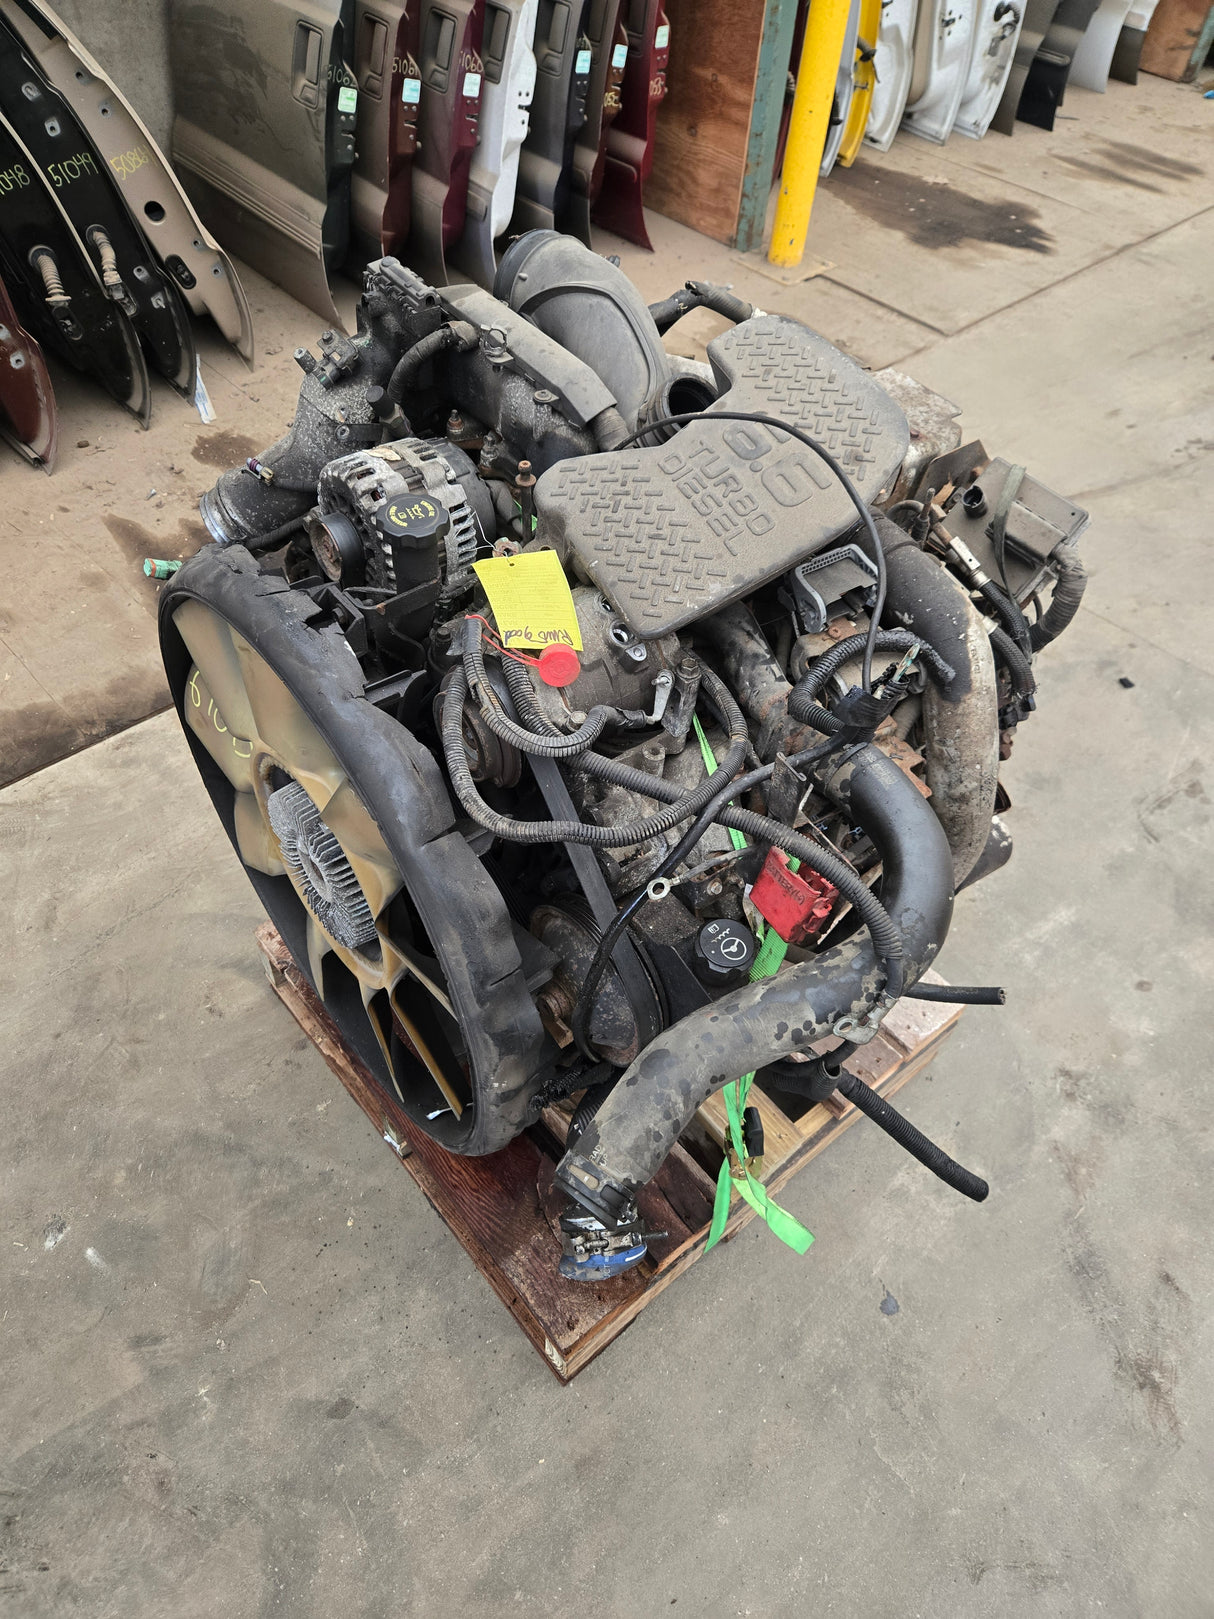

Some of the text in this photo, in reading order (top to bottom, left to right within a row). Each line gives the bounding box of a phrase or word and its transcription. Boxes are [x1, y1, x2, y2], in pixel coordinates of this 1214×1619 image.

[47, 152, 99, 187] 51049
[658, 453, 744, 557] DIESEL
[689, 440, 776, 536] TURBO
[723, 412, 832, 508] 6.6
